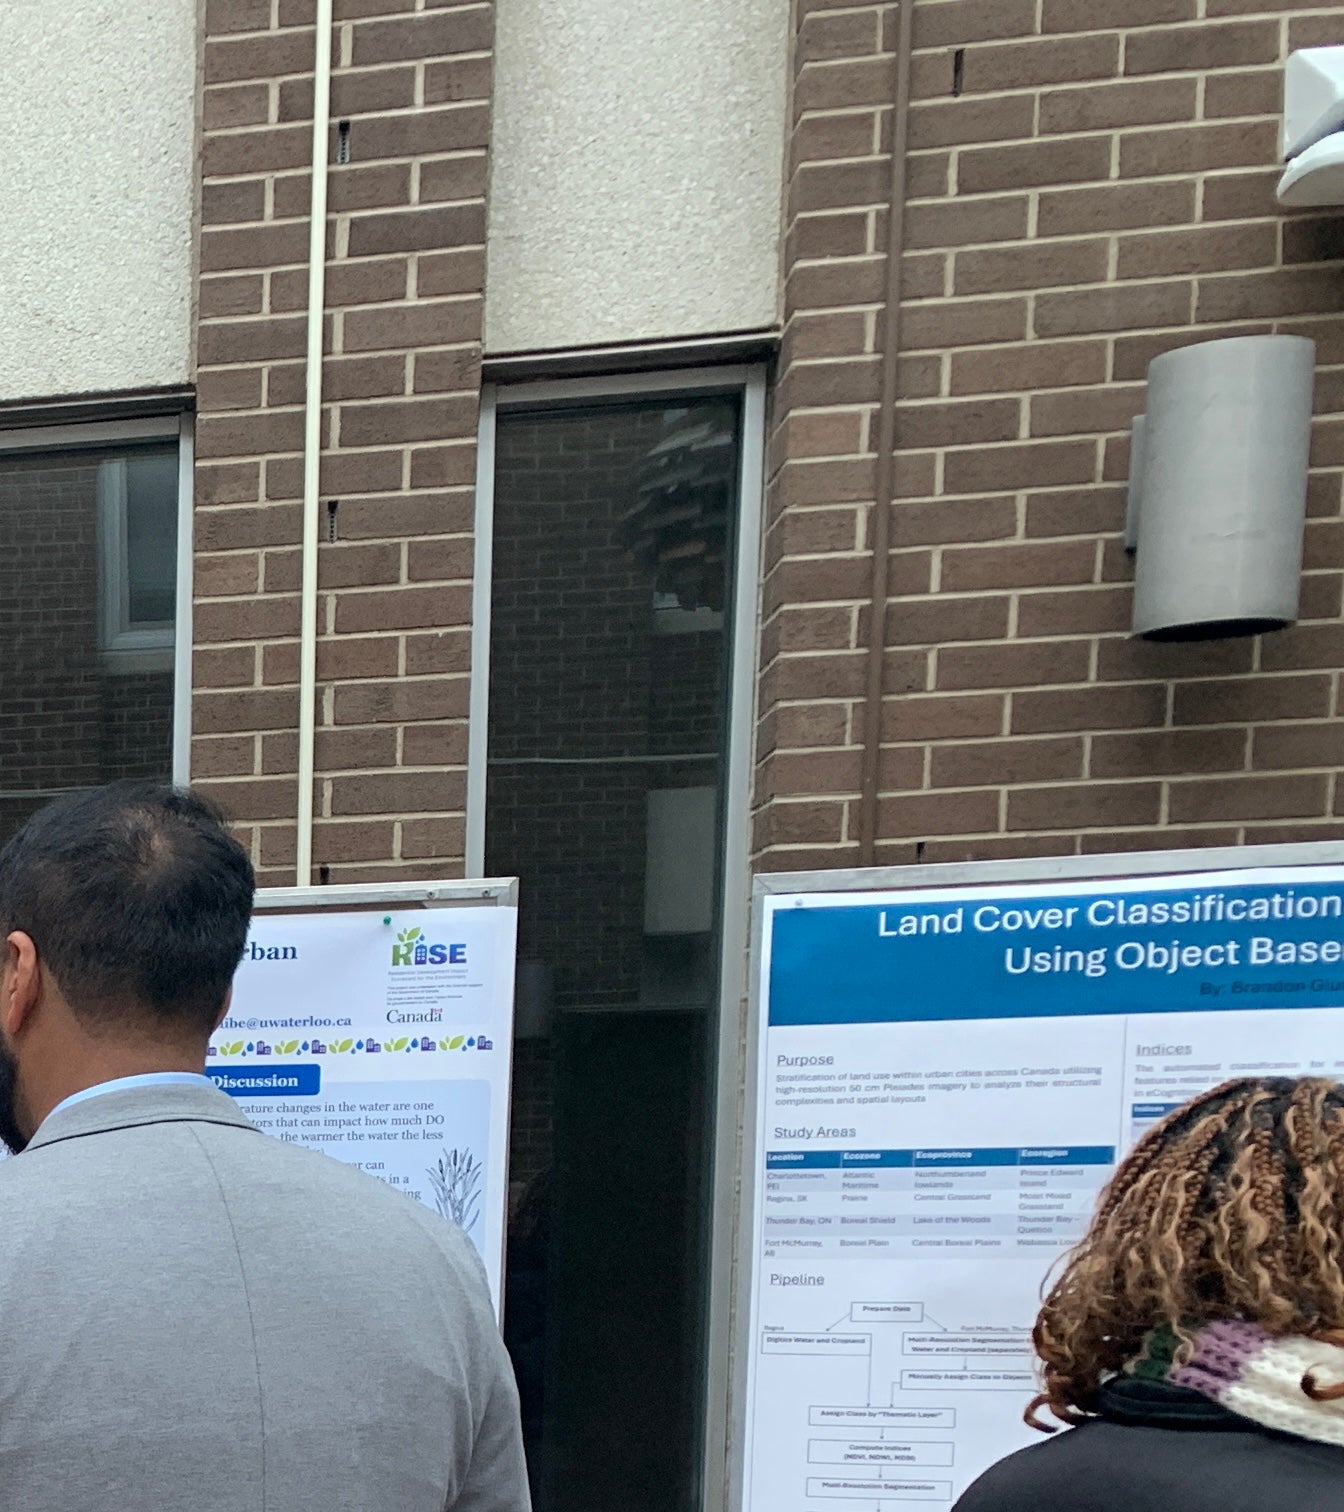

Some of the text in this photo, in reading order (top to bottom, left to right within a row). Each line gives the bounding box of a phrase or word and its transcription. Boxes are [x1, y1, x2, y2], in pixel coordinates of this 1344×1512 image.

[878, 889, 1343, 938] Land Cover Classification
[391, 941, 467, 967] RISE
[1005, 934, 1344, 981] Using Object Base
[218, 1015, 352, 1029] libe@uwaterloo.ca
[386, 1007, 443, 1024] Canada
[1136, 1043, 1193, 1056] Indices
[776, 1054, 835, 1068] Purpose
[210, 1073, 299, 1089] Discussion
[276, 1099, 435, 1115] changes in the water are one
[774, 1126, 857, 1139] Study Areas
[770, 1273, 825, 1287] Pipeline
